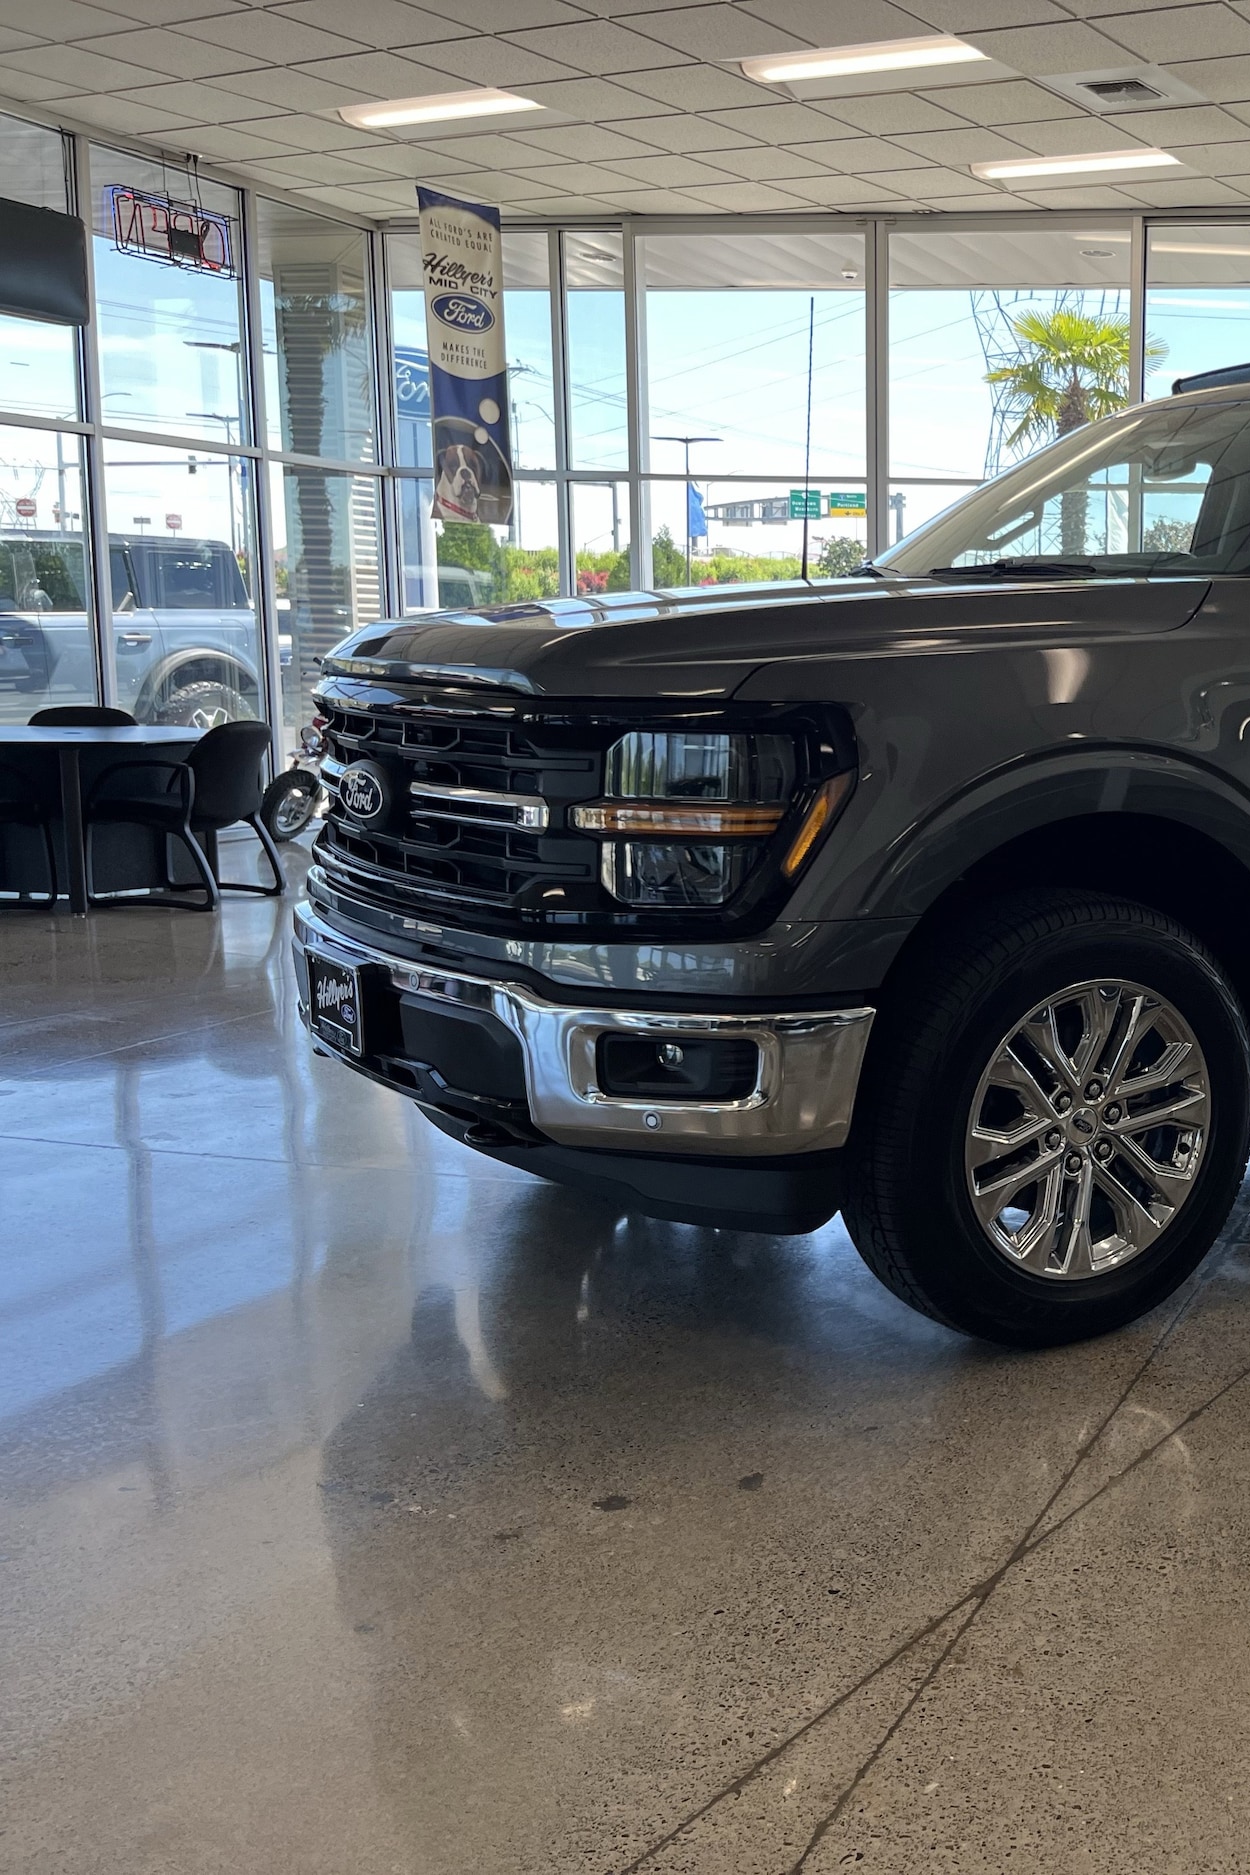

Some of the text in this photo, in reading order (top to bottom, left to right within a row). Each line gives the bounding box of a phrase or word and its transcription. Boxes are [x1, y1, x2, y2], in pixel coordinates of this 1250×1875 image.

[430, 217, 493, 242] ALL FORD'S ARE
[430, 229, 492, 253] CREATED EQUAL
[422, 252, 494, 288] Hillyer's
[428, 276, 498, 299] MID CITY
[443, 299, 485, 329] Ford
[440, 352, 487, 370] DIFFERENCE
[442, 341, 485, 359] MAKES THE
[346, 772, 373, 811] Ford
[317, 975, 353, 1010] Hillyer's
